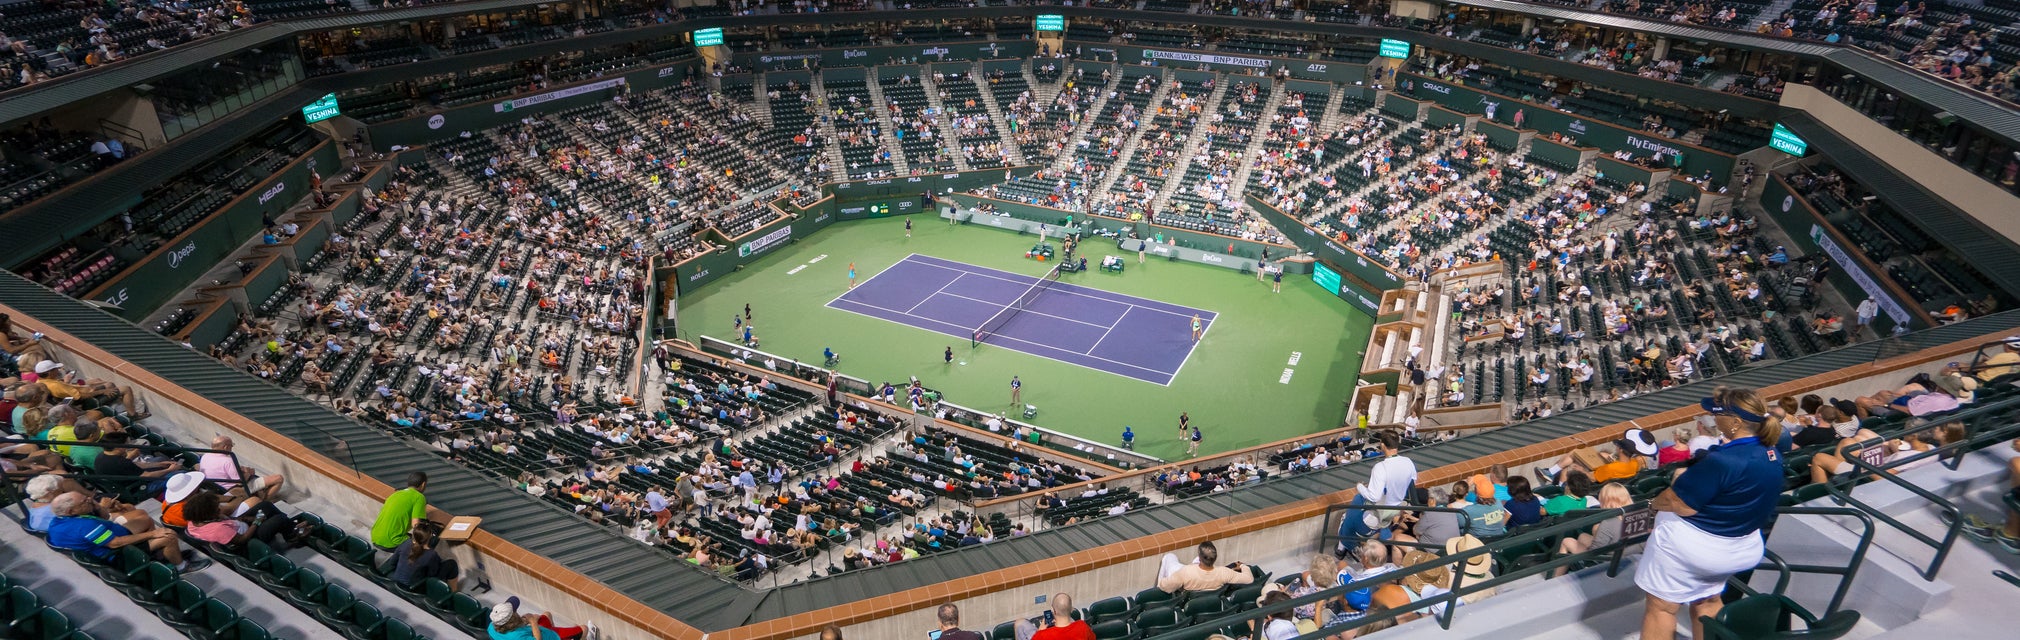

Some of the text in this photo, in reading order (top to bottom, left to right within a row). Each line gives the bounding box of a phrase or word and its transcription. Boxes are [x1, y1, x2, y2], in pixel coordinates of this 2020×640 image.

[1153, 51, 1174, 59] BANK
[1180, 53, 1202, 61] WEST
[1213, 56, 1231, 64] BNP
[658, 67, 674, 77] ATP
[1306, 63, 1327, 72] ATP
[1422, 81, 1452, 95] ORACLE
[513, 93, 556, 108] BNP PARIBAS
[307, 107, 338, 121] VESNINA
[429, 117, 445, 126] WTA
[1627, 135, 1680, 157] Fly Emirates
[1773, 137, 1802, 155] VESNINA
[258, 182, 285, 205] HEAD
[751, 226, 790, 250] BNP PARIBAS
[177, 240, 196, 262] pepsi
[690, 268, 709, 282] ROLEX
[1624, 511, 1649, 524] SECTION
[1624, 519, 1646, 535] 412
